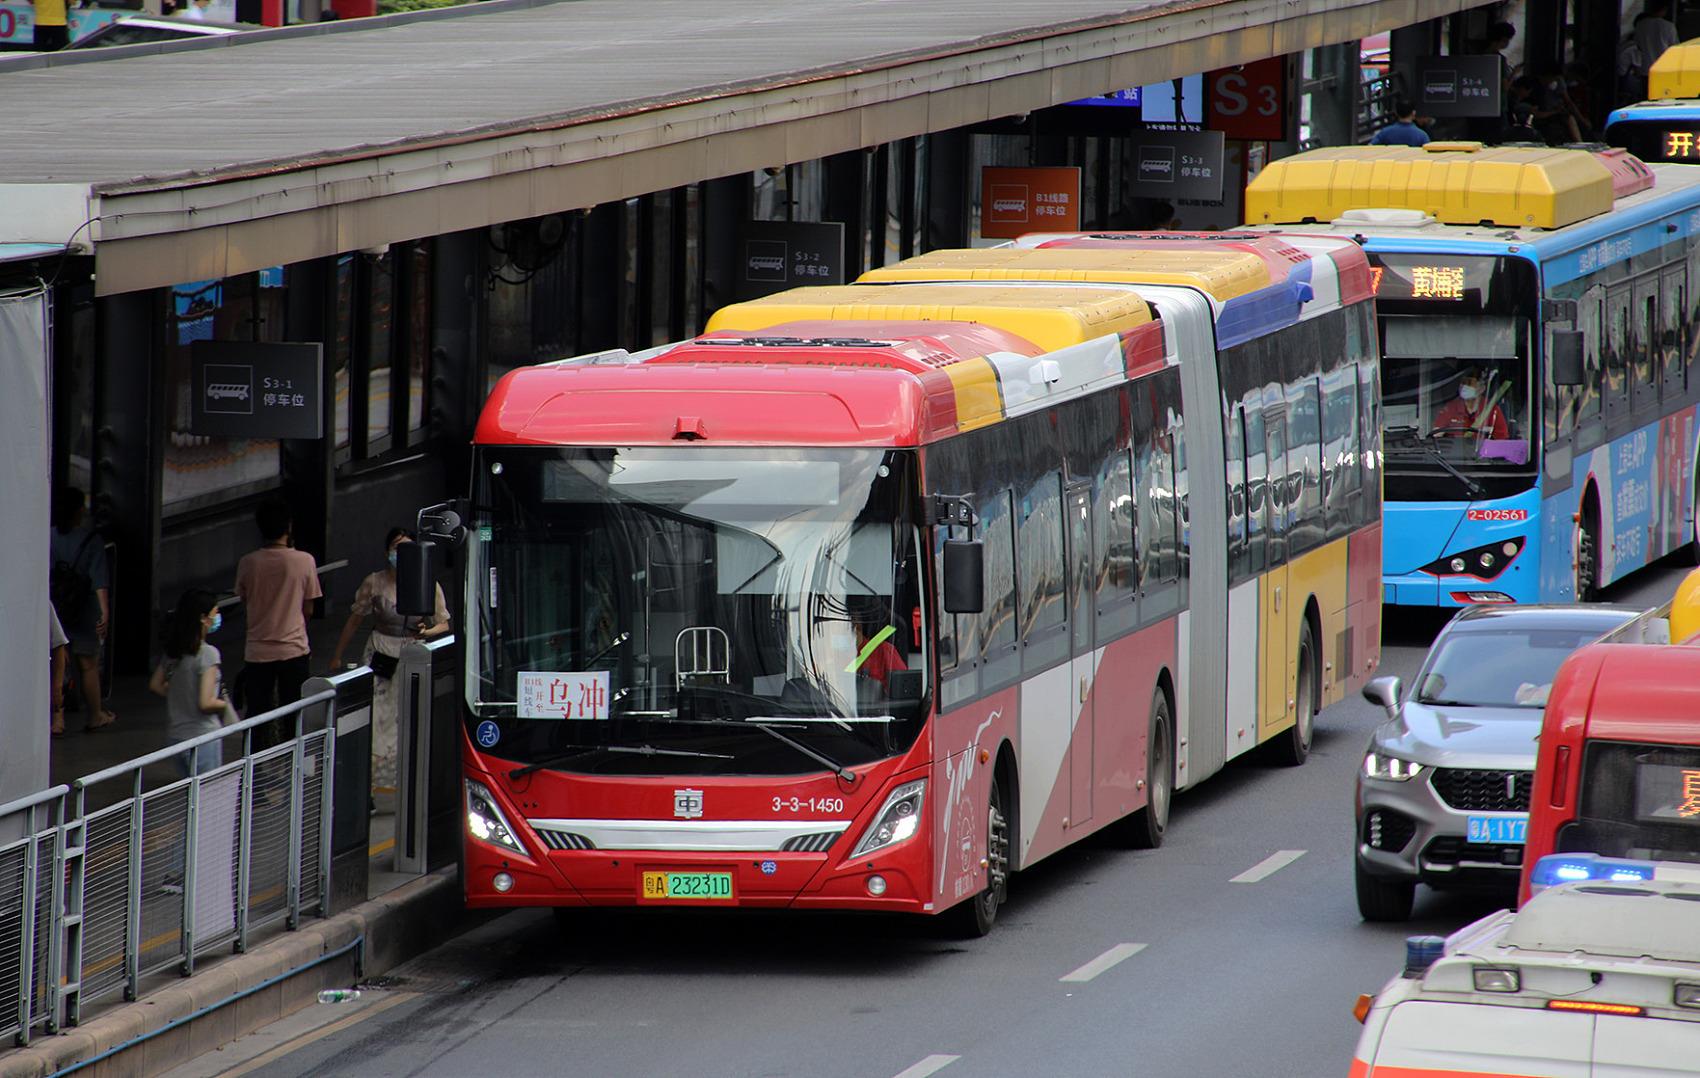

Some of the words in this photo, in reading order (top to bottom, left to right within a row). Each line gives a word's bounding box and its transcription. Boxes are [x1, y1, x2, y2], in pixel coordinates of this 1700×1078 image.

[1666, 132, 1700, 157] 开
[1180, 166, 1213, 178] 停车位
[1035, 205, 1067, 216] 停车位
[794, 250, 821, 262] S3-2
[794, 264, 830, 277] 停车位
[263, 377, 293, 389] S3-1
[263, 393, 305, 407] 停车位
[1468, 509, 1526, 521] 2-02561
[545, 678, 604, 720] 乌冲
[771, 797, 844, 813] 3-3-1450
